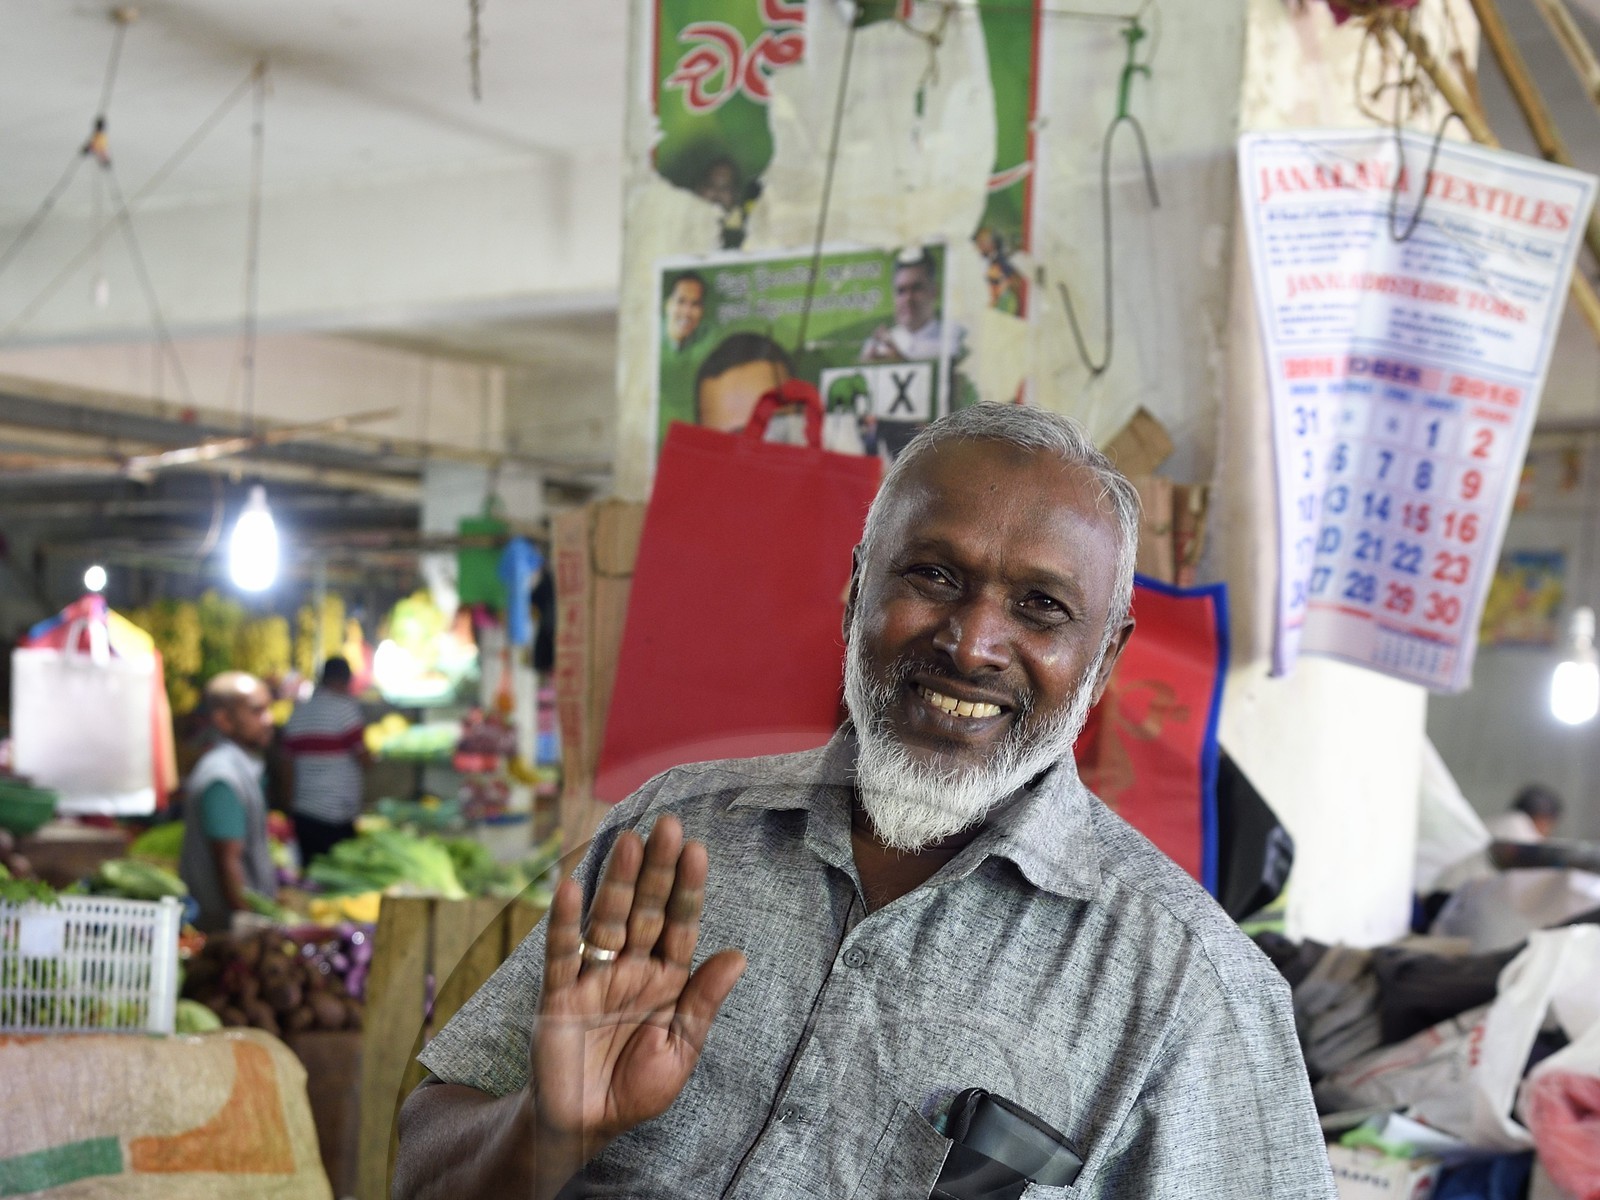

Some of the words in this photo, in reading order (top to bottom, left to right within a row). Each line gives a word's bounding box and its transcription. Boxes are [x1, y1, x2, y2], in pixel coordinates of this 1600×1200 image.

[1424, 170, 1573, 232] TEXTILES
[1450, 375, 1522, 408] 2016
[1295, 406, 1319, 436] 31
[1427, 420, 1441, 448] 1
[1471, 428, 1494, 459] 2
[1377, 449, 1393, 480] 7
[1414, 460, 1434, 491] 8
[1460, 470, 1482, 500] 9
[1362, 491, 1391, 522] 14
[1402, 503, 1431, 534] 15
[1444, 512, 1479, 544] 16
[1354, 530, 1384, 563] 21
[1391, 541, 1424, 575] 22
[1432, 551, 1471, 585] 23
[1342, 570, 1377, 604] 28
[1383, 581, 1416, 615] 29
[1424, 591, 1461, 625] 30
